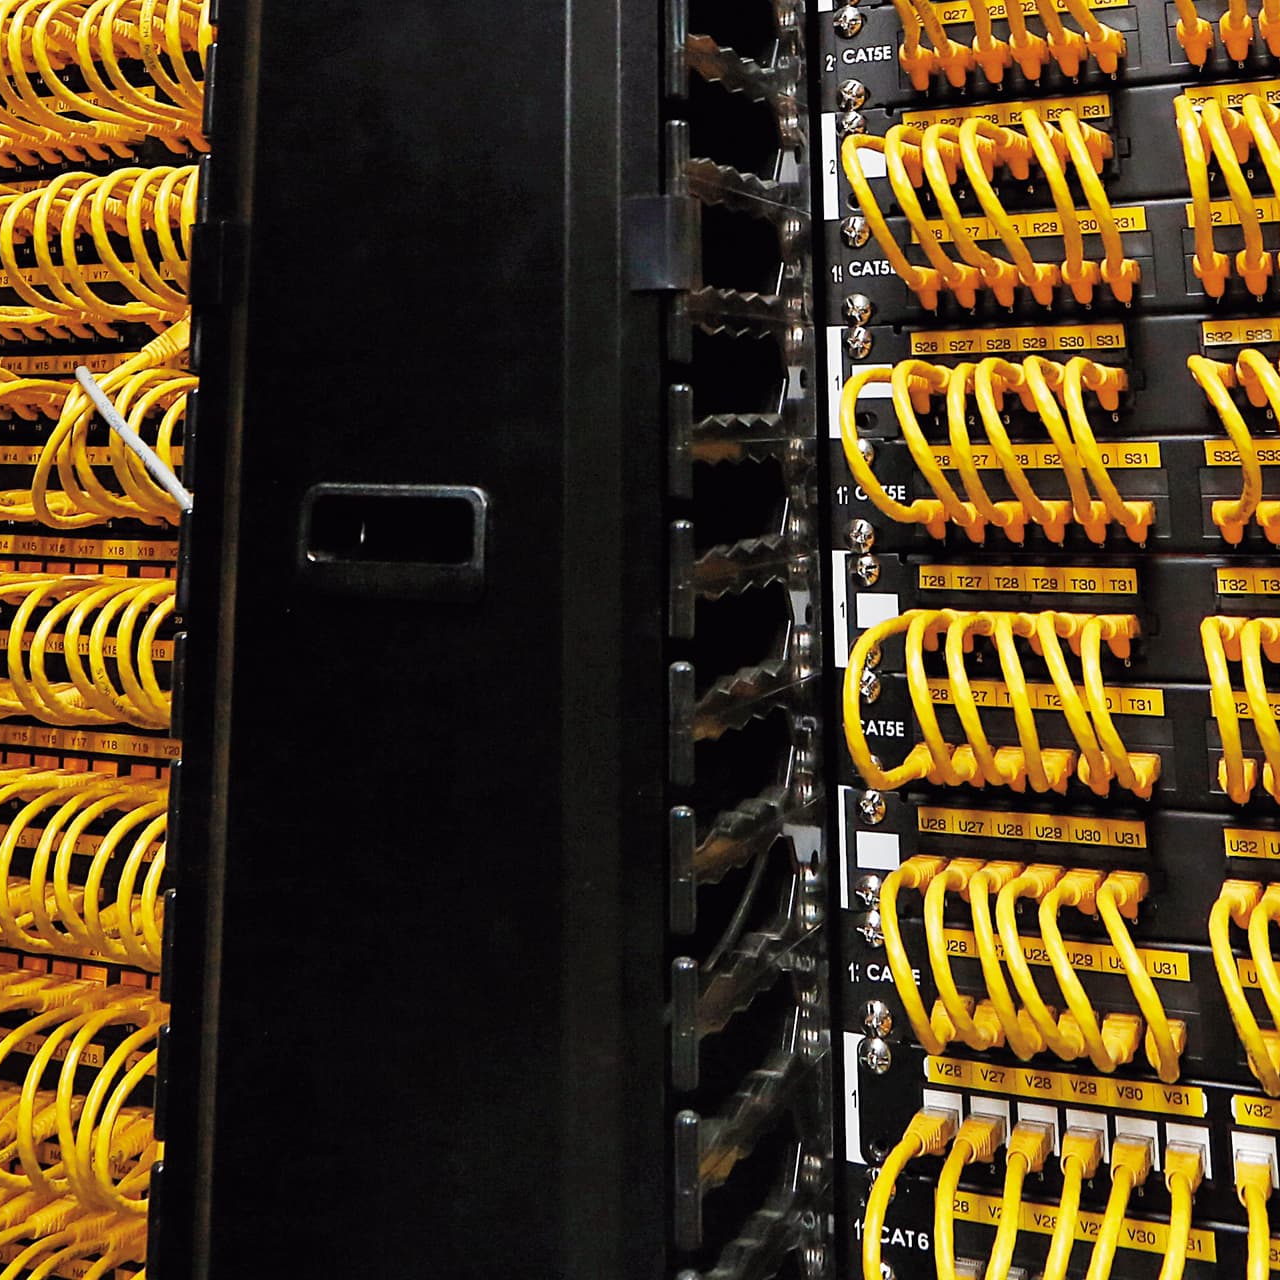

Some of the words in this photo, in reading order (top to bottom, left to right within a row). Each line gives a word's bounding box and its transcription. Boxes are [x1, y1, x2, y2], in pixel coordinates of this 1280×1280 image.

[943, 8, 968, 21] Q27
[843, 46, 892, 64] CAT5E
[1083, 105, 1106, 115] R31
[1033, 222, 1058, 233] R29
[1206, 332, 1232, 342] S32
[1246, 329, 1272, 340] S33
[915, 341, 938, 352] S26
[986, 339, 1011, 350] S28
[1059, 336, 1084, 347] S30
[1096, 335, 1120, 345] S31
[1125, 454, 1148, 464] S31
[922, 576, 945, 587] T26
[957, 577, 982, 587] T27
[1032, 578, 1058, 589] T29
[1110, 579, 1133, 591] T31
[1220, 579, 1247, 591] T32
[163, 744, 180, 756] Y20
[921, 819, 946, 830] U26
[959, 821, 984, 833] U27
[1036, 826, 1062, 839] U29
[1115, 832, 1141, 845] U31
[1230, 839, 1258, 854] U32
[1154, 962, 1178, 975] U31
[936, 1062, 962, 1078] V26
[980, 1069, 1005, 1084] V27
[1071, 1080, 1097, 1095] V29
[1164, 1091, 1190, 1106] V31
[1244, 1102, 1273, 1119] V32
[1128, 1228, 1156, 1245] V30
